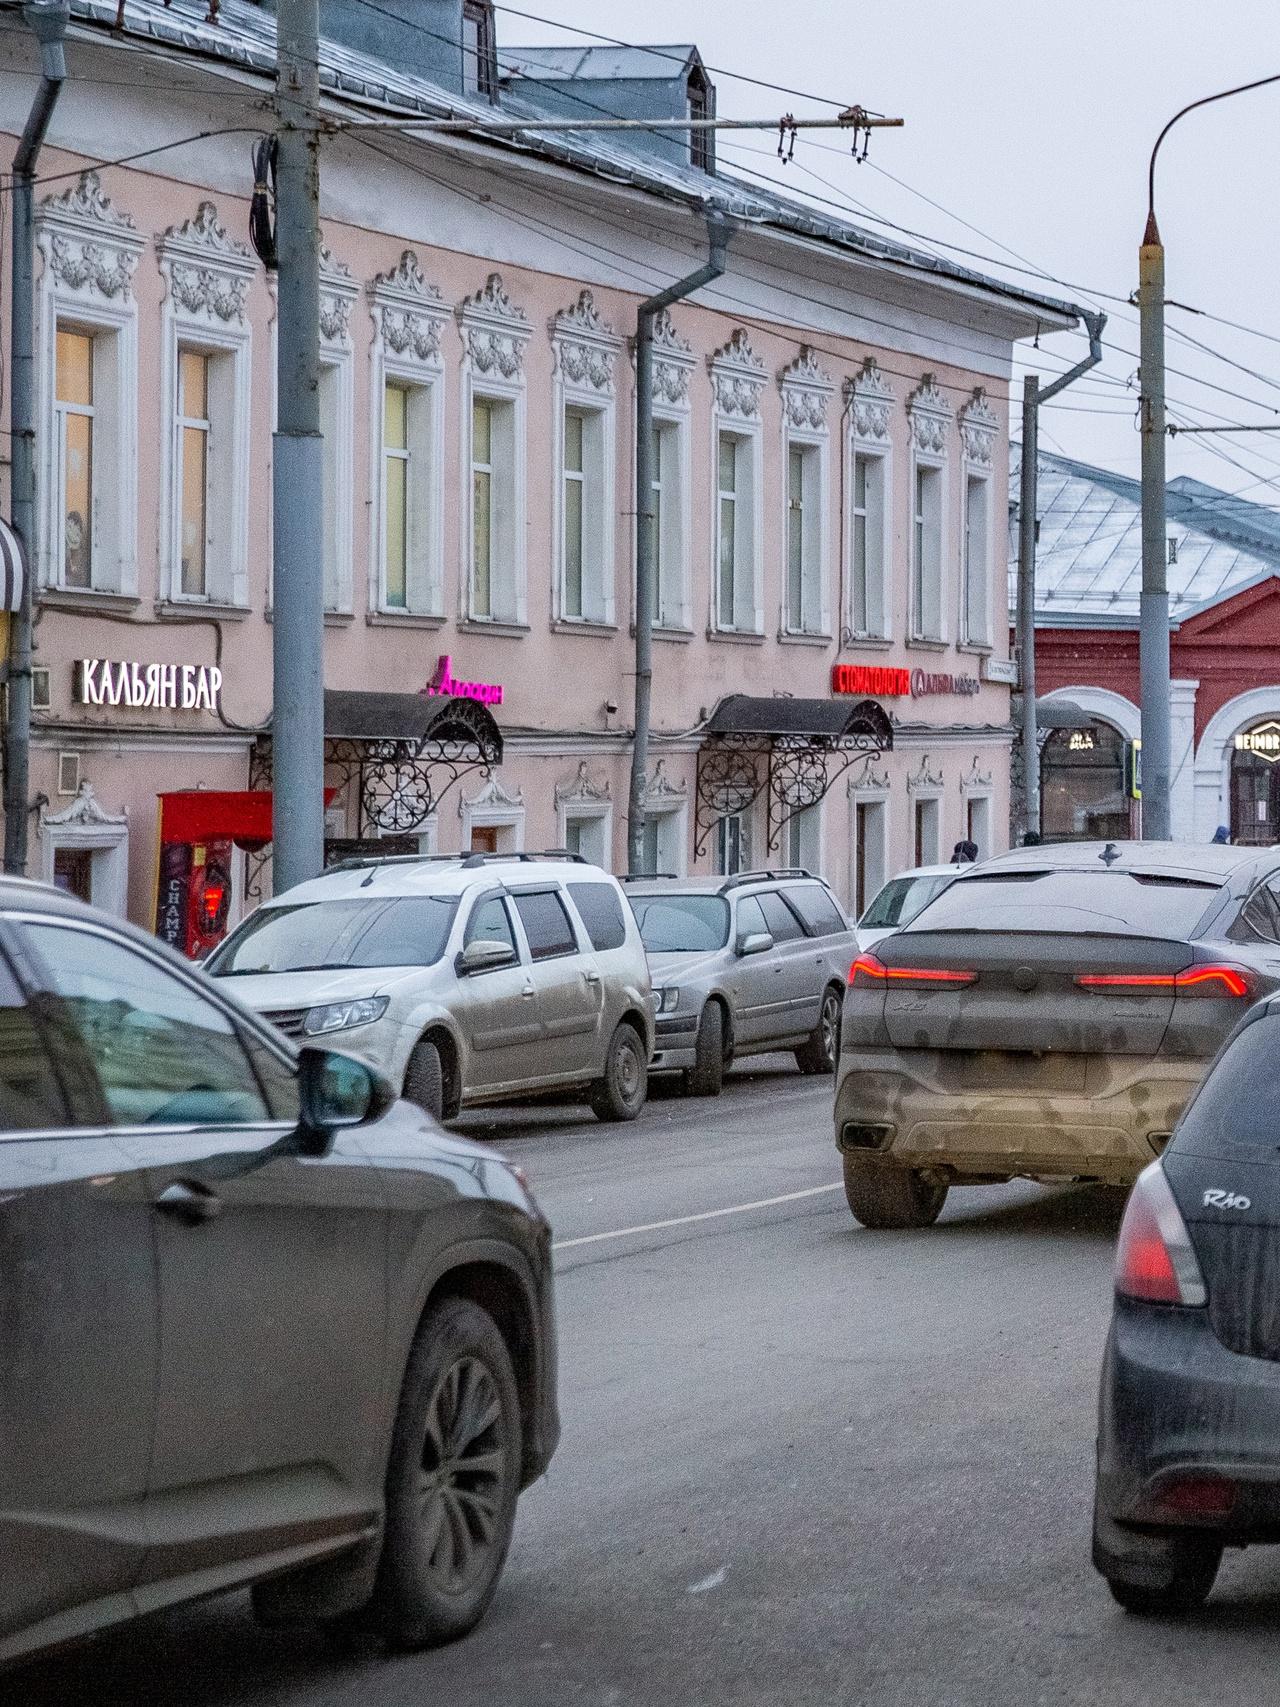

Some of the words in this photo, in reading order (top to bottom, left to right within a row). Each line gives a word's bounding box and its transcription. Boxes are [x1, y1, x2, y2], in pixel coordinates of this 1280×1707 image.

[83, 659, 176, 708] КАЛЬЯН
[182, 666, 222, 709] БАР
[1202, 1189, 1251, 1211] Rio
